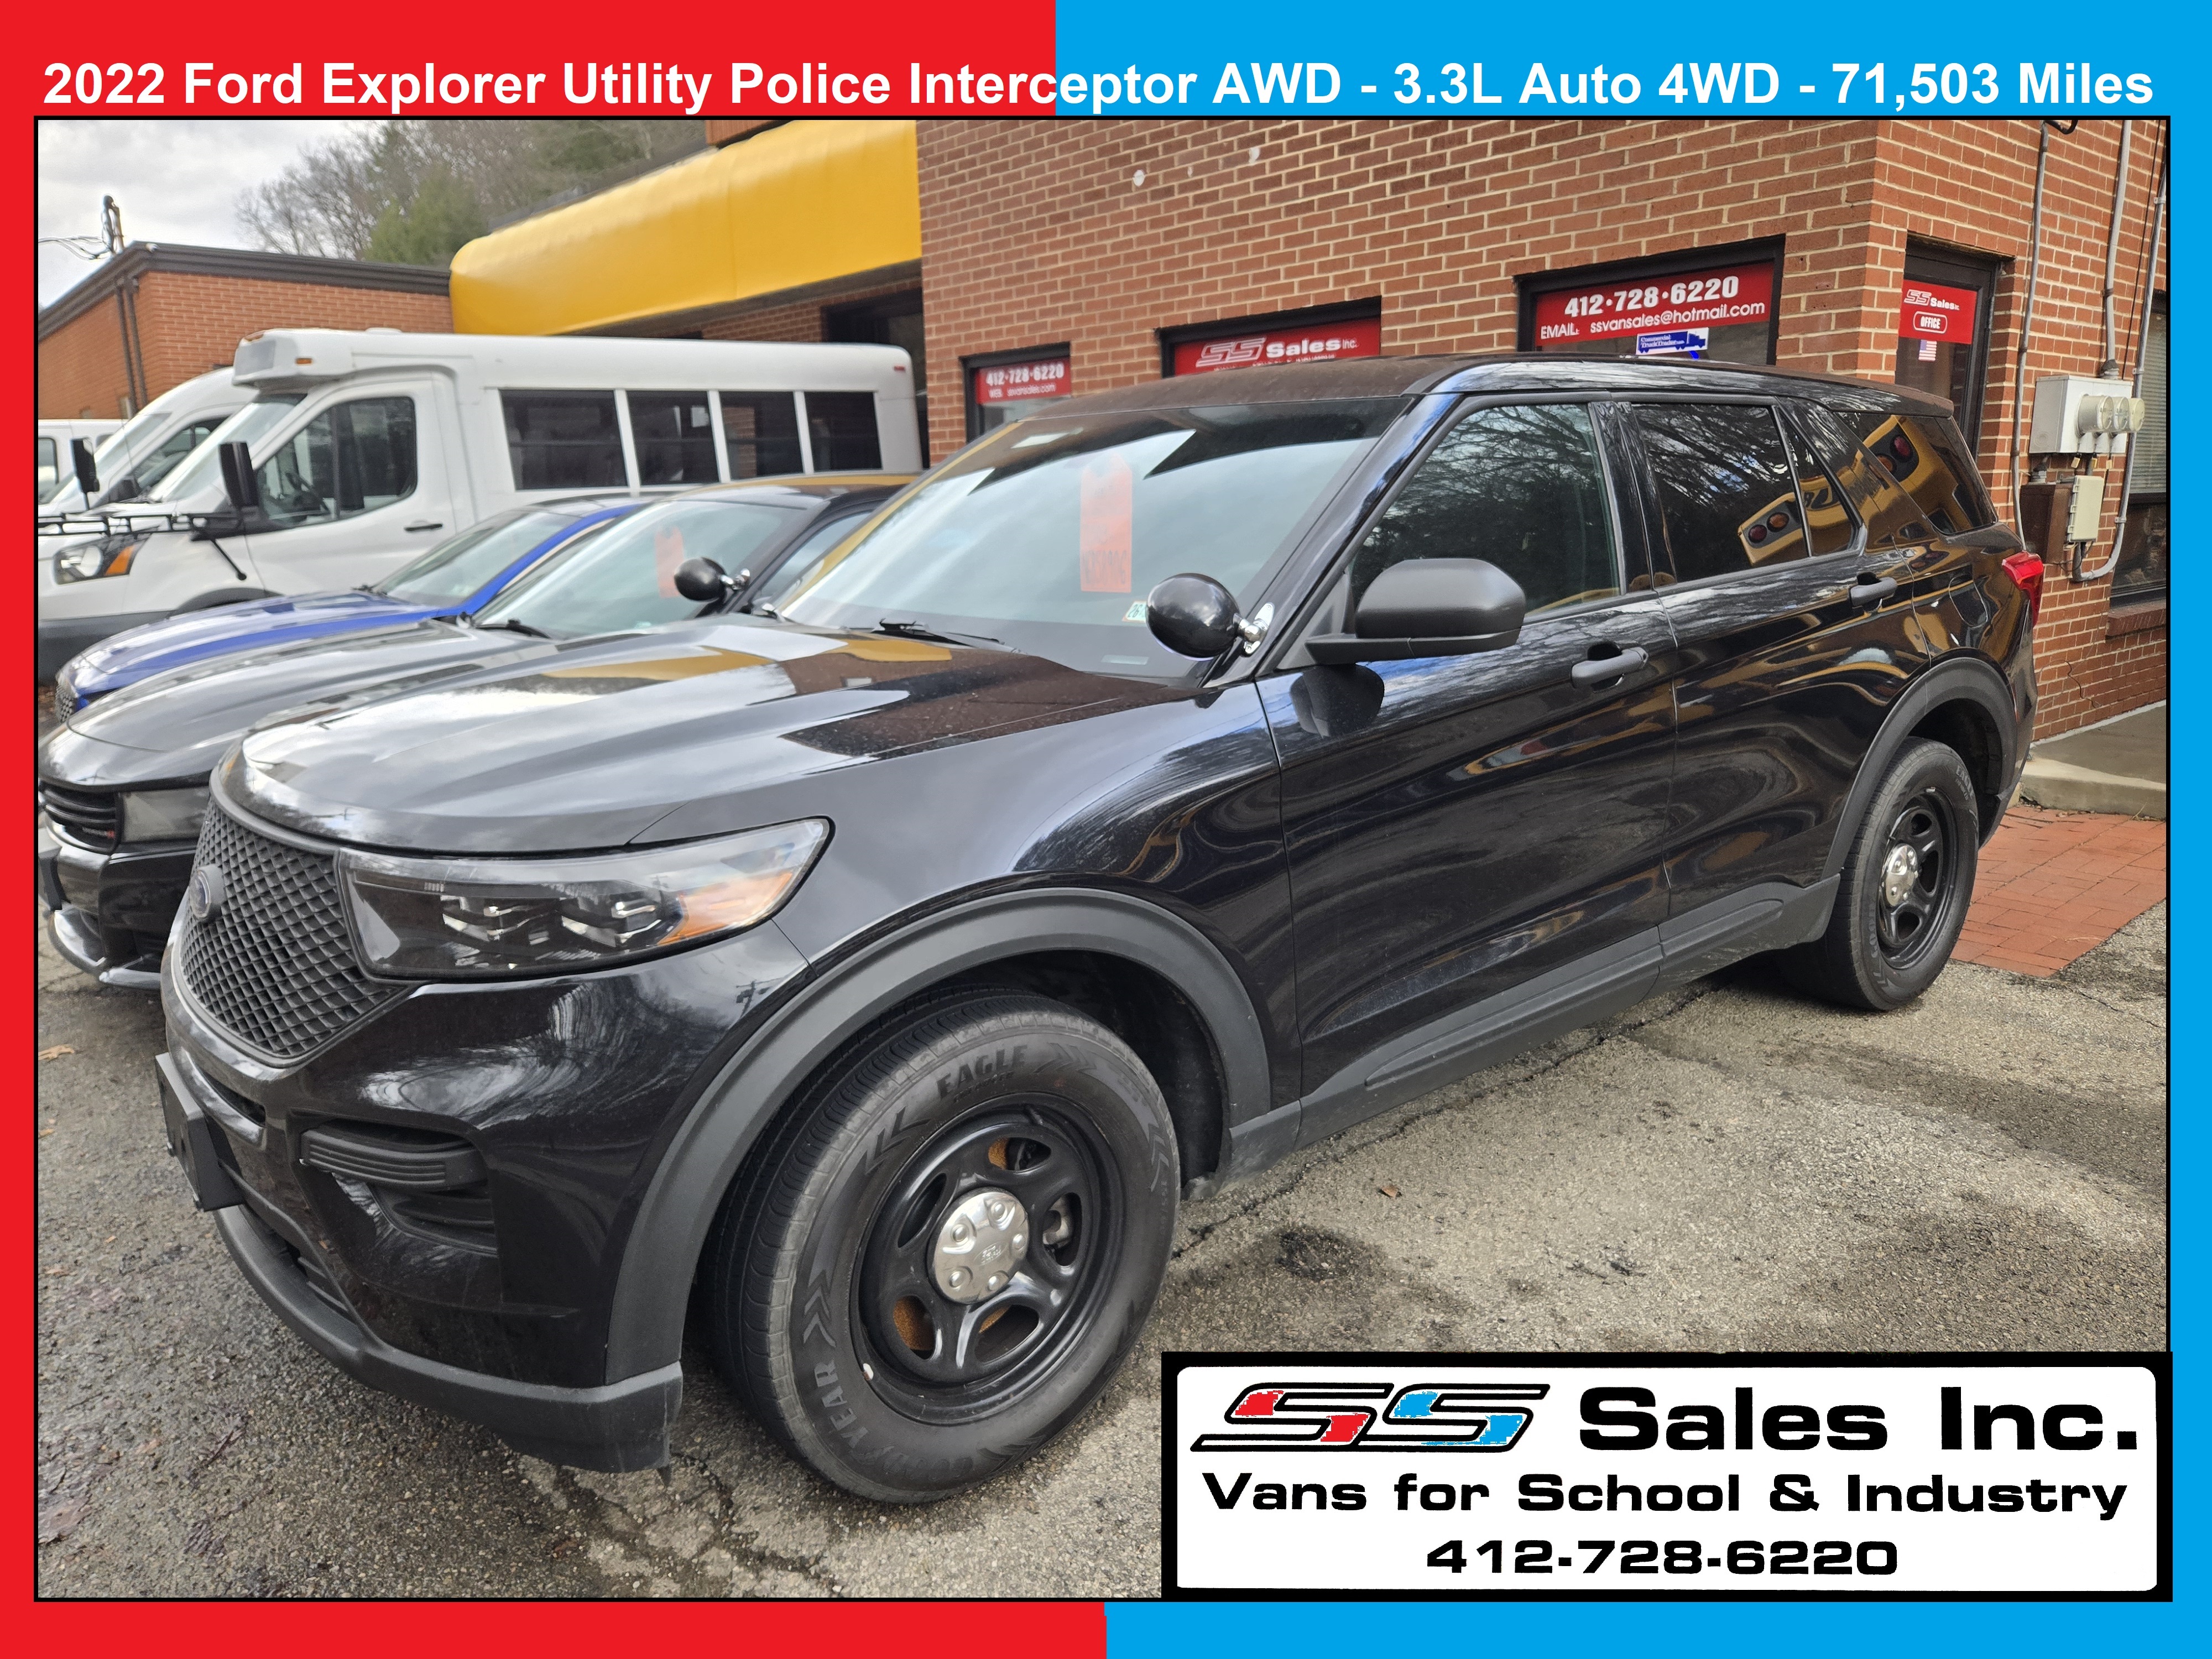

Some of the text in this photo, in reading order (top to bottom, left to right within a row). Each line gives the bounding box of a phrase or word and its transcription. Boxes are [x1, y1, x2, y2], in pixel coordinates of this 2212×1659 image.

[1903, 289, 1932, 306] SS
[1930, 297, 1955, 310] Sales
[1540, 301, 1766, 340] EMAIL: ssvansales@hotmail.com
[1920, 316, 1941, 330] OFFICE
[1195, 336, 1267, 368] SS
[1266, 338, 1342, 358] Sales
[936, 1044, 1028, 1099] EAGLE
[814, 1359, 869, 1449] YEAR
